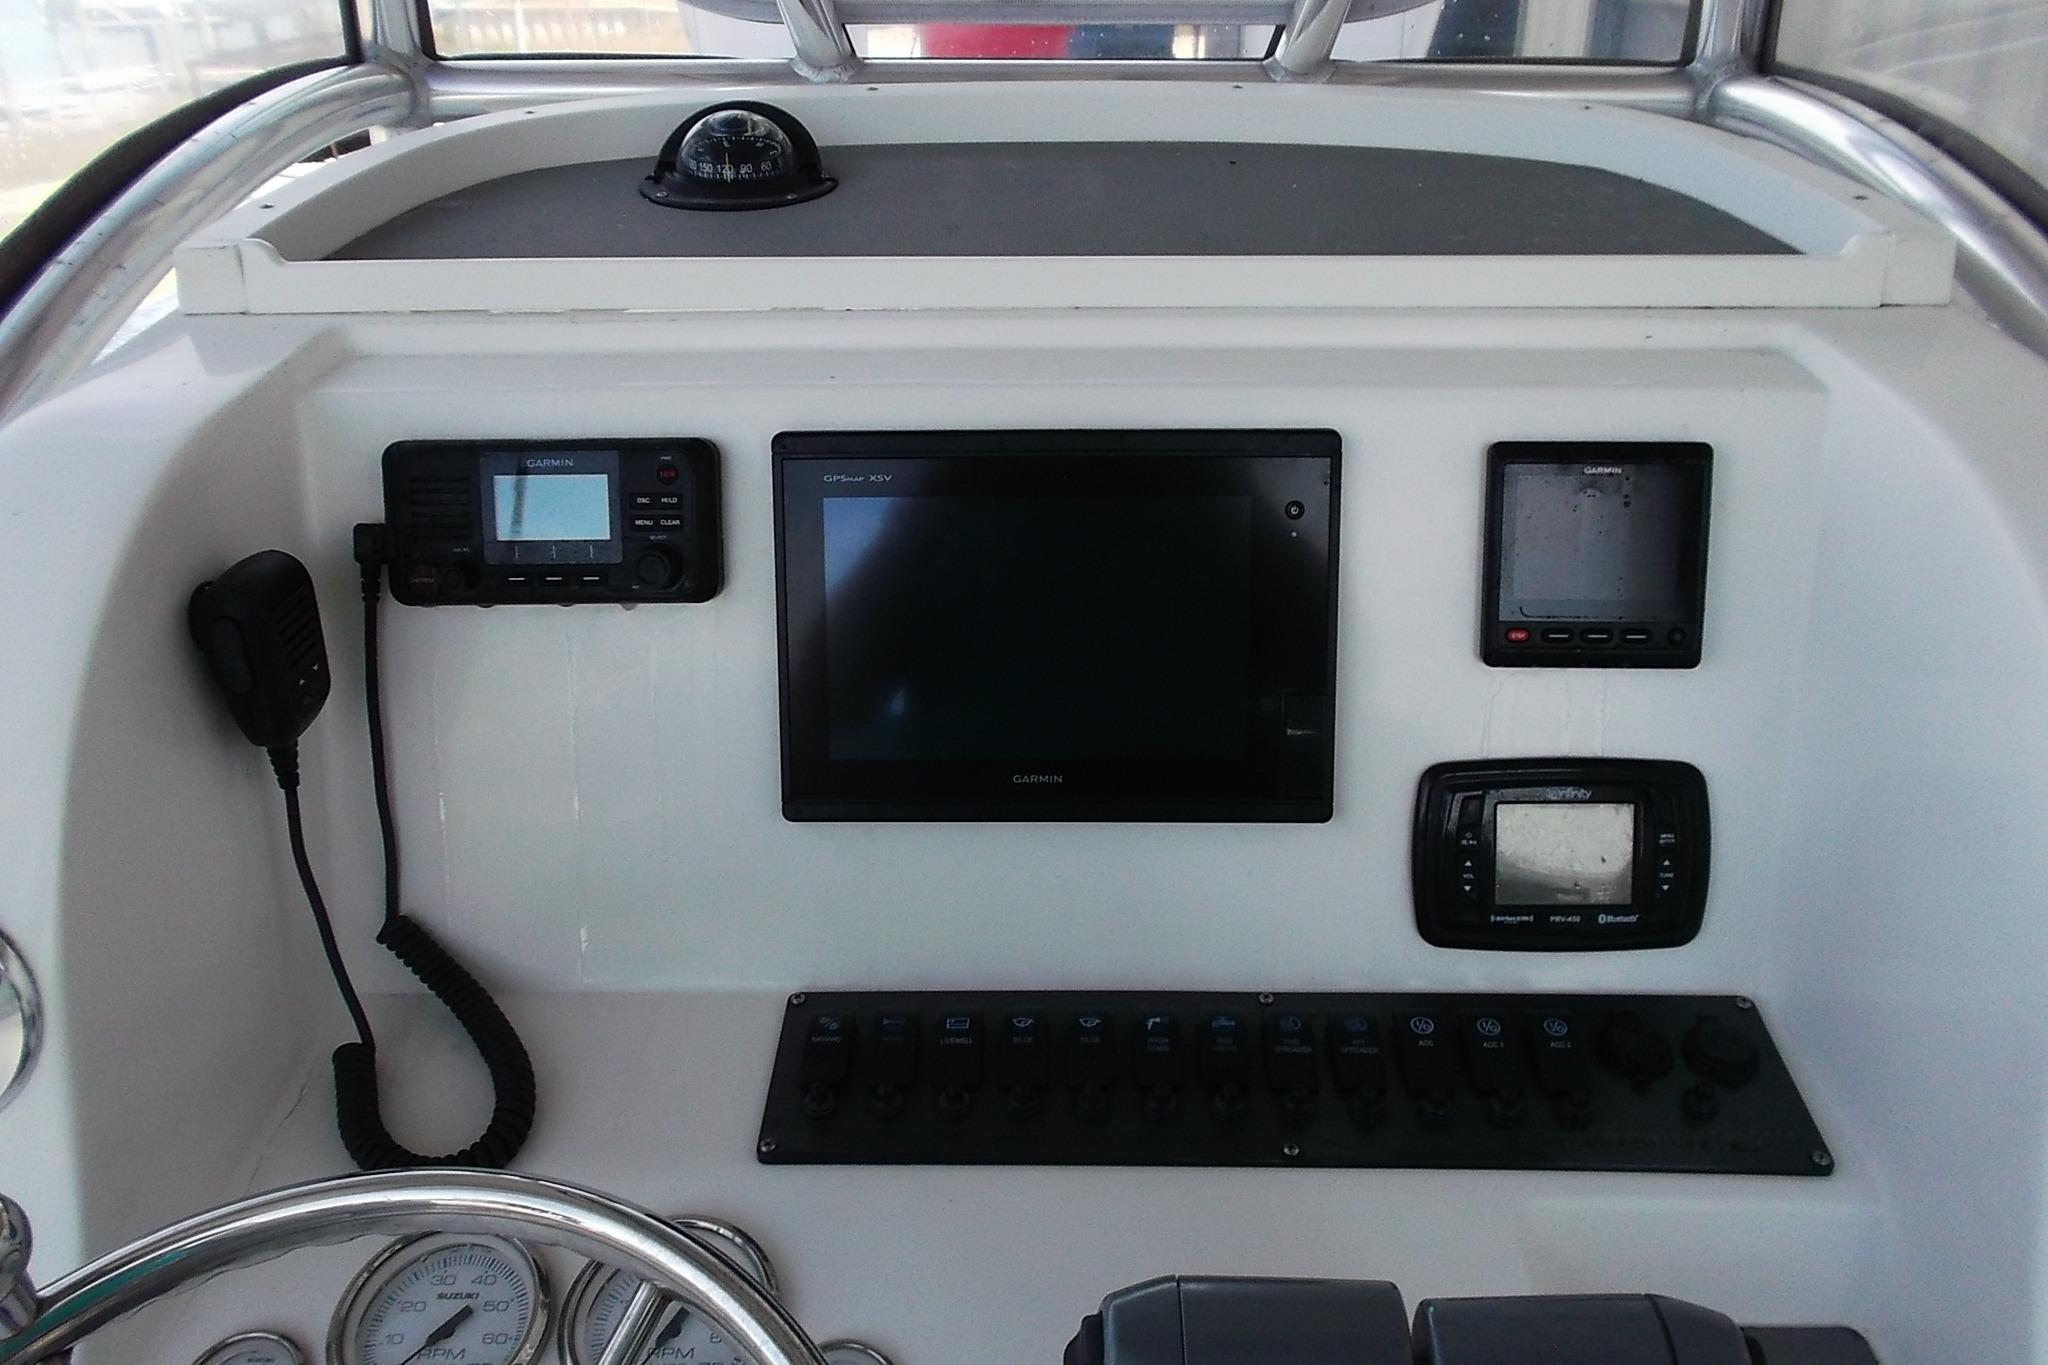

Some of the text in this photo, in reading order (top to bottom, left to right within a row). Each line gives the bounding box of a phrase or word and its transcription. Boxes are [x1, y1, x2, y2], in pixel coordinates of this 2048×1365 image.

[699, 162, 714, 174] 150
[716, 163, 734, 175] 120
[739, 163, 753, 175] 90
[760, 160, 772, 172] 60
[526, 458, 574, 469] GARMIN
[1583, 465, 1623, 475] GARMIN
[868, 474, 893, 482] XSV
[636, 496, 651, 504] DSC
[634, 518, 681, 527] MENU CLEAR
[1012, 773, 1063, 784] GARMIN
[430, 1274, 457, 1286] 30
[471, 1274, 497, 1286] 40
[436, 1291, 481, 1301] SUZUKI
[399, 1300, 427, 1313] 20
[482, 1300, 510, 1313] 50
[384, 1332, 405, 1345] 10
[481, 1332, 509, 1345] 60
[415, 1347, 467, 1361] RPM
[646, 1346, 695, 1360] RPM
